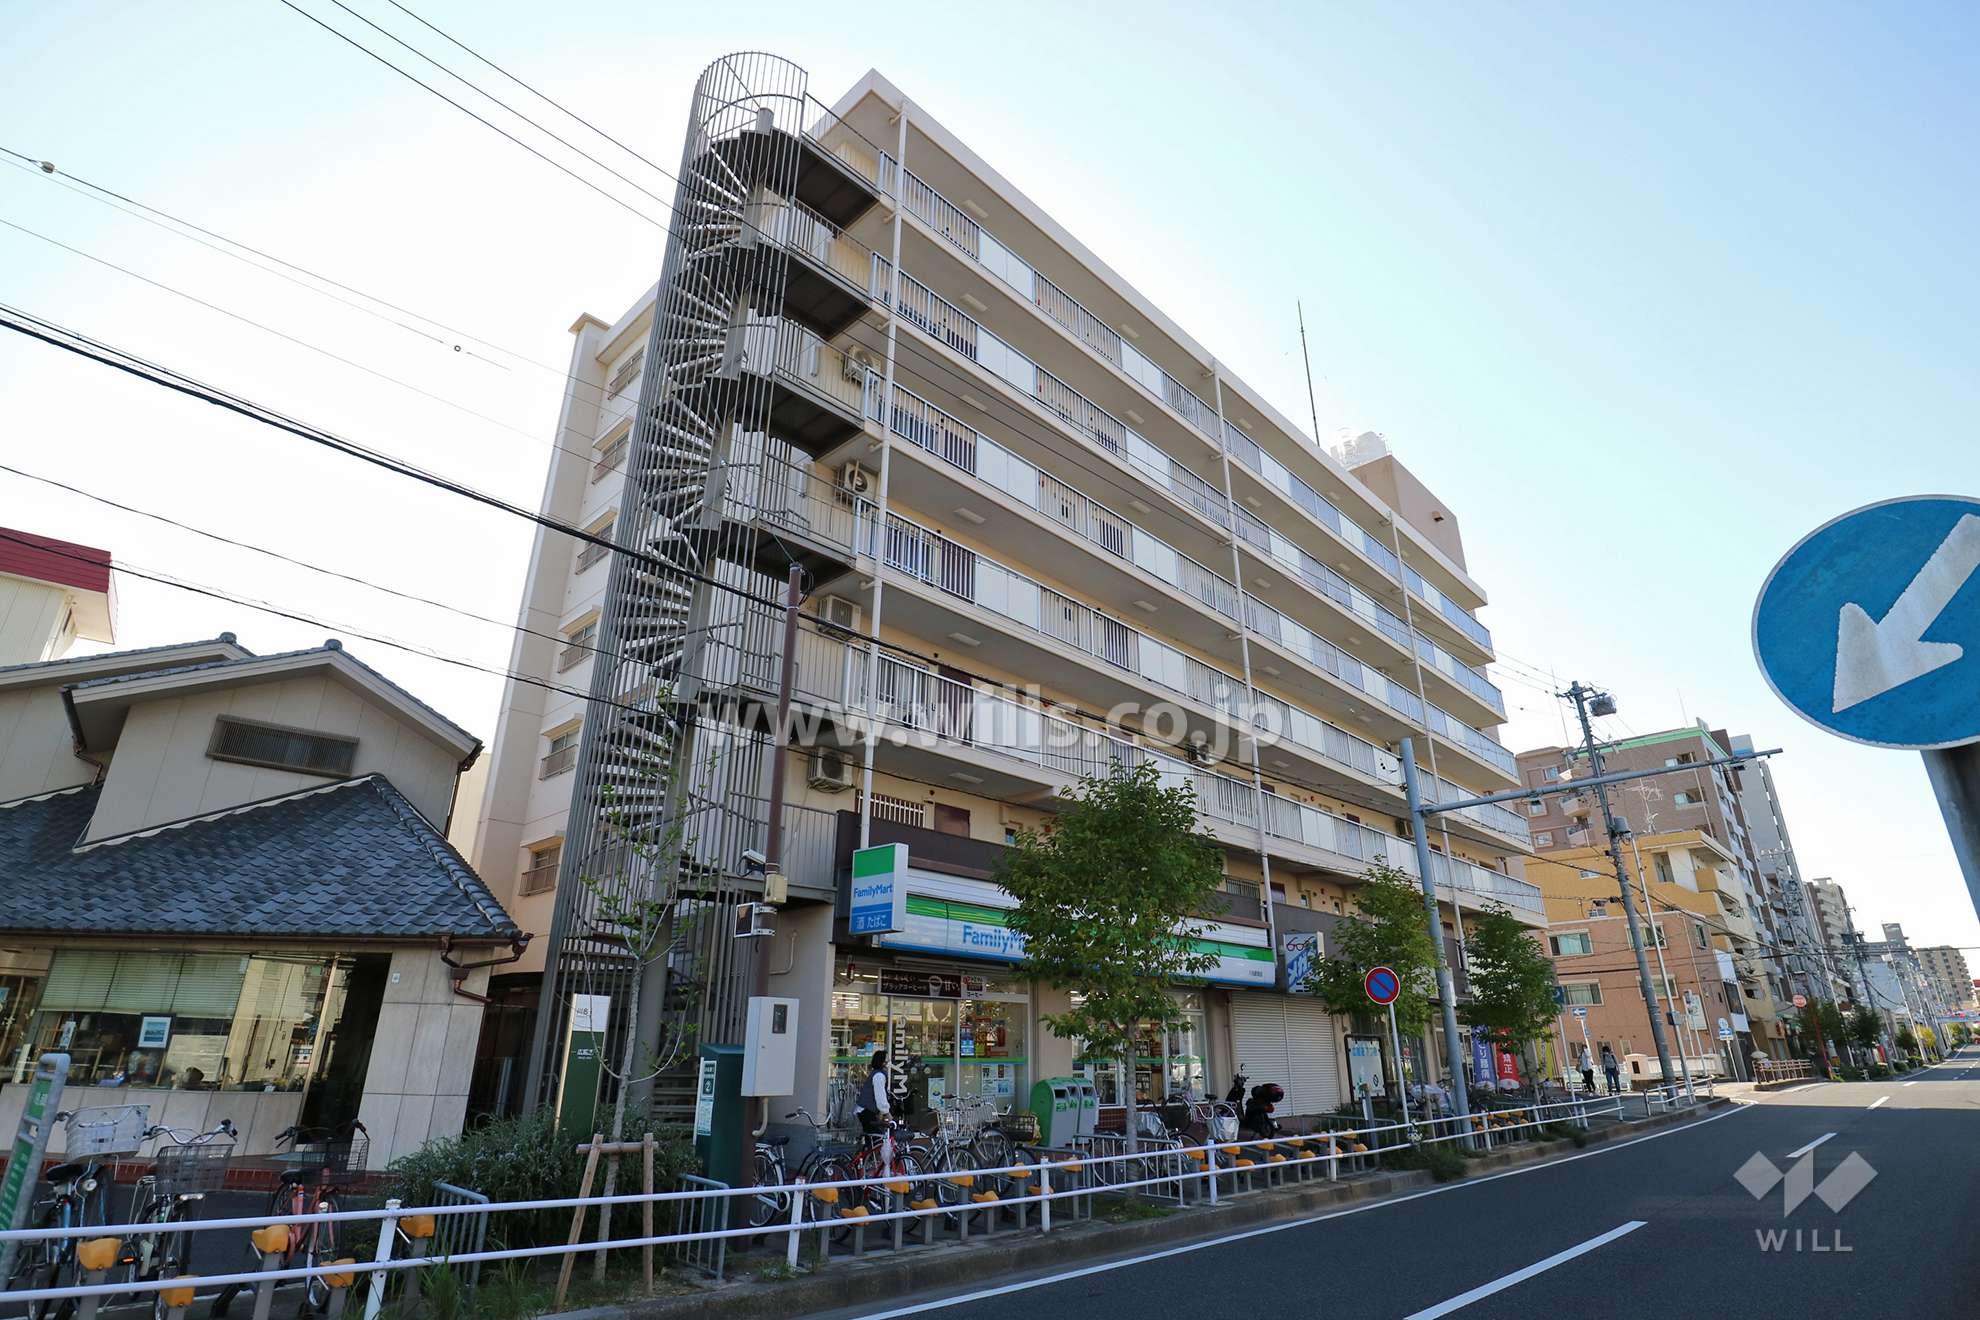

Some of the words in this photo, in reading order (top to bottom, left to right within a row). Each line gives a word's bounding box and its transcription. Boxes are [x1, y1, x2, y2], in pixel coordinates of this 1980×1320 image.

[854, 883, 893, 898] FamilyMart
[867, 914, 887, 929] たばこ
[963, 924, 1025, 952] FamilyM
